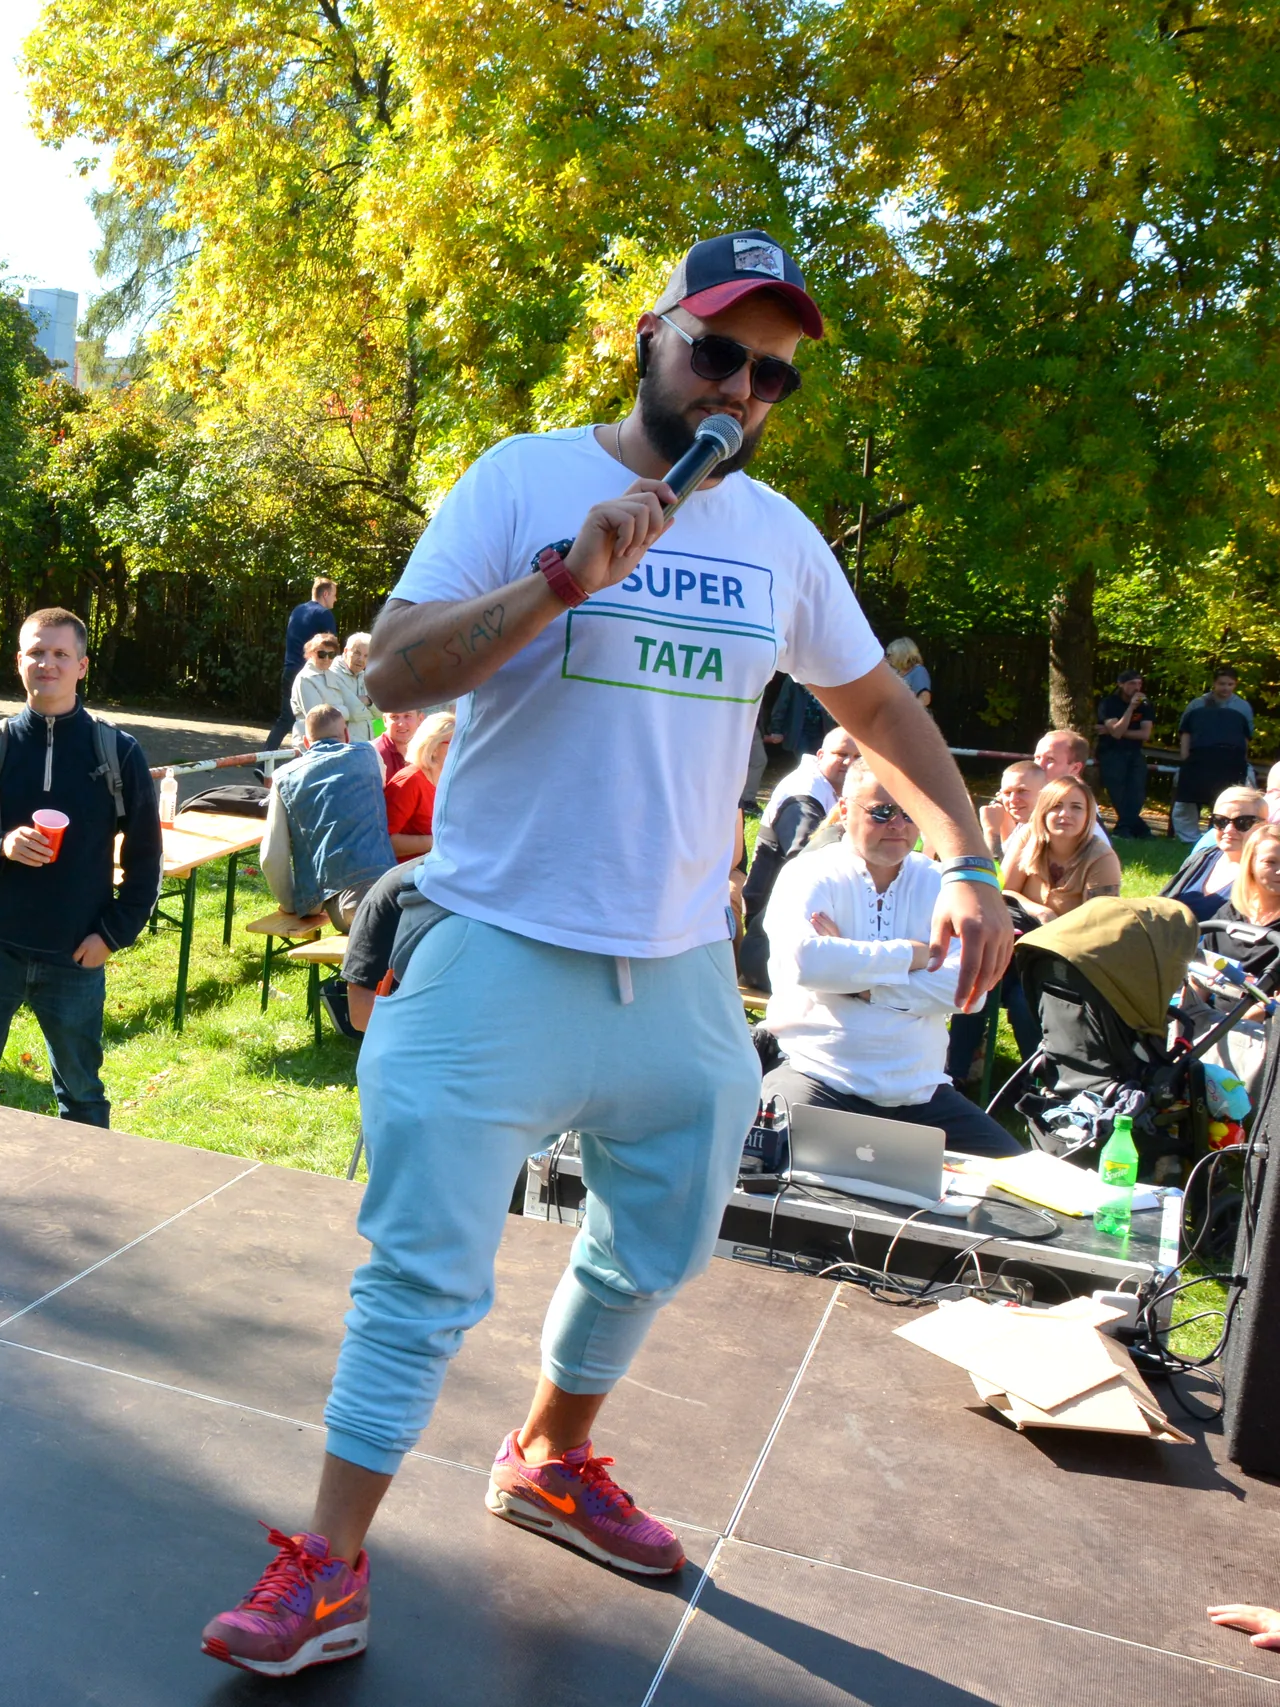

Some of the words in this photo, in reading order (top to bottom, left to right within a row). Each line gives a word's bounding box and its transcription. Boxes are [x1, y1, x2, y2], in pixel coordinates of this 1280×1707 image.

[621, 563, 746, 609] SUPER
[634, 635, 723, 683] TATA
[1104, 1168, 1130, 1181] Sprite
